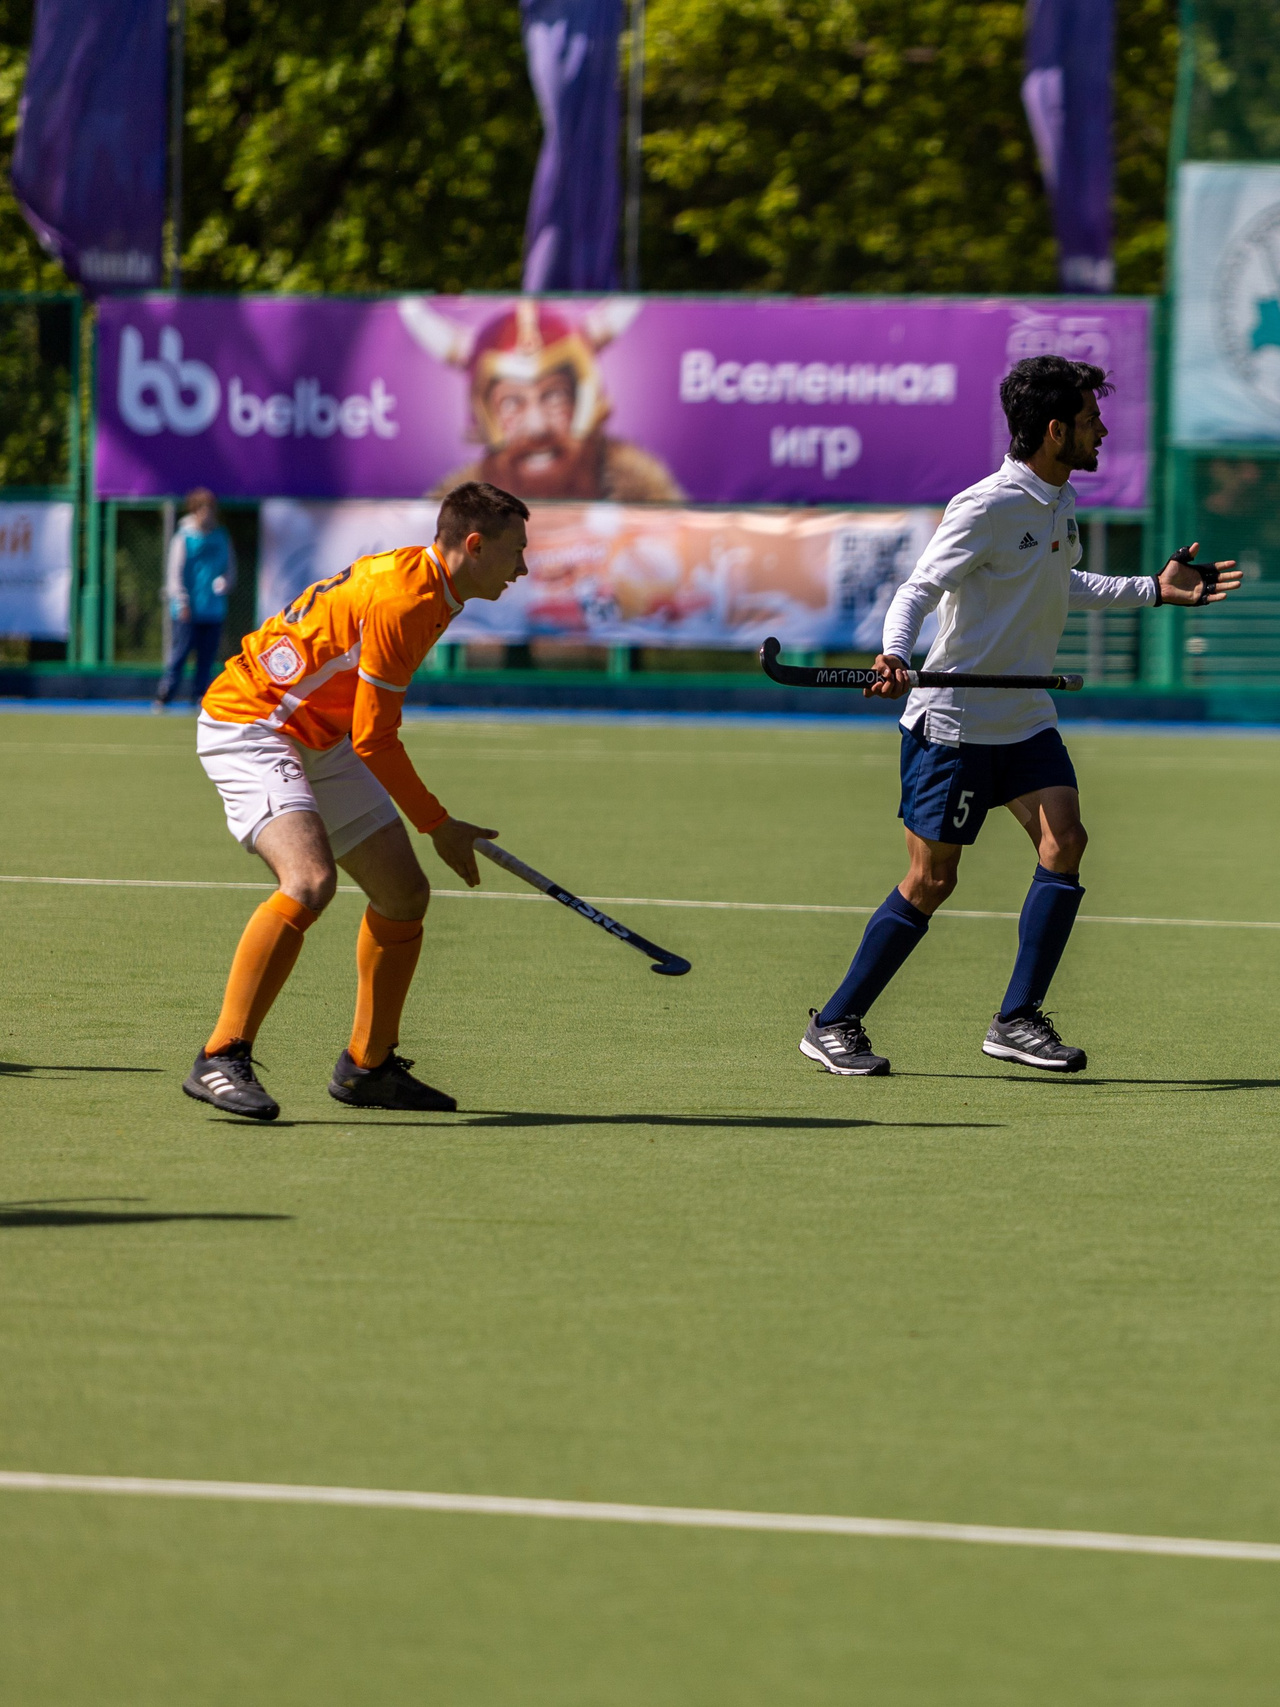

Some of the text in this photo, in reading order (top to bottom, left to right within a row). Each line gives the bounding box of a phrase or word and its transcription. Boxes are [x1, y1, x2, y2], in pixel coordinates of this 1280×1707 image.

[679, 349, 957, 404] Вселенная
[228, 377, 397, 440] belbet
[770, 424, 861, 478] игр
[1018, 540, 1038, 550] adidas
[952, 789, 975, 829] 5
